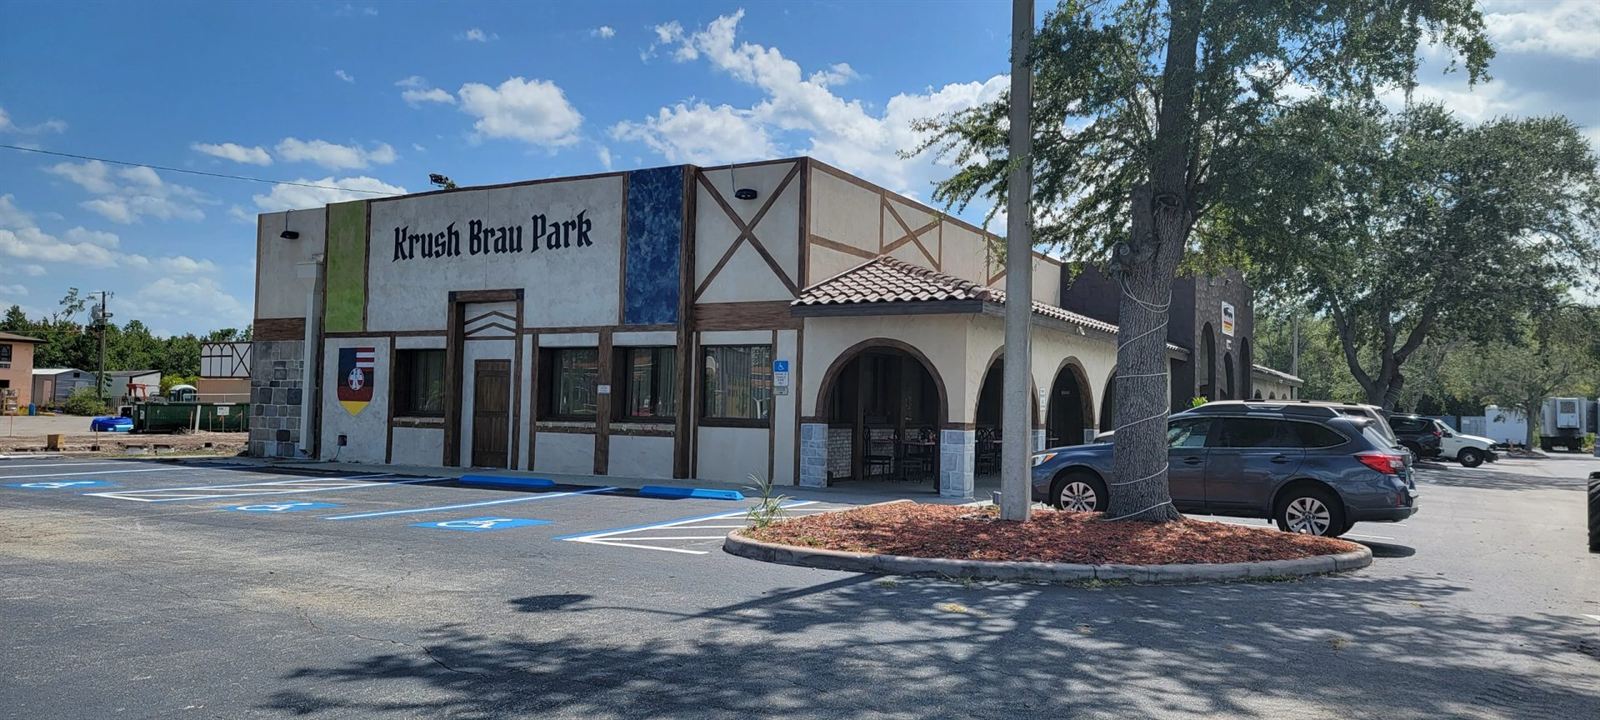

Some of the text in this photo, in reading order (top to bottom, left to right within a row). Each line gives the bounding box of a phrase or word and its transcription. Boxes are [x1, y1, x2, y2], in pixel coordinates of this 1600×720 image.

[392, 209, 593, 262] Krush Brau Park
